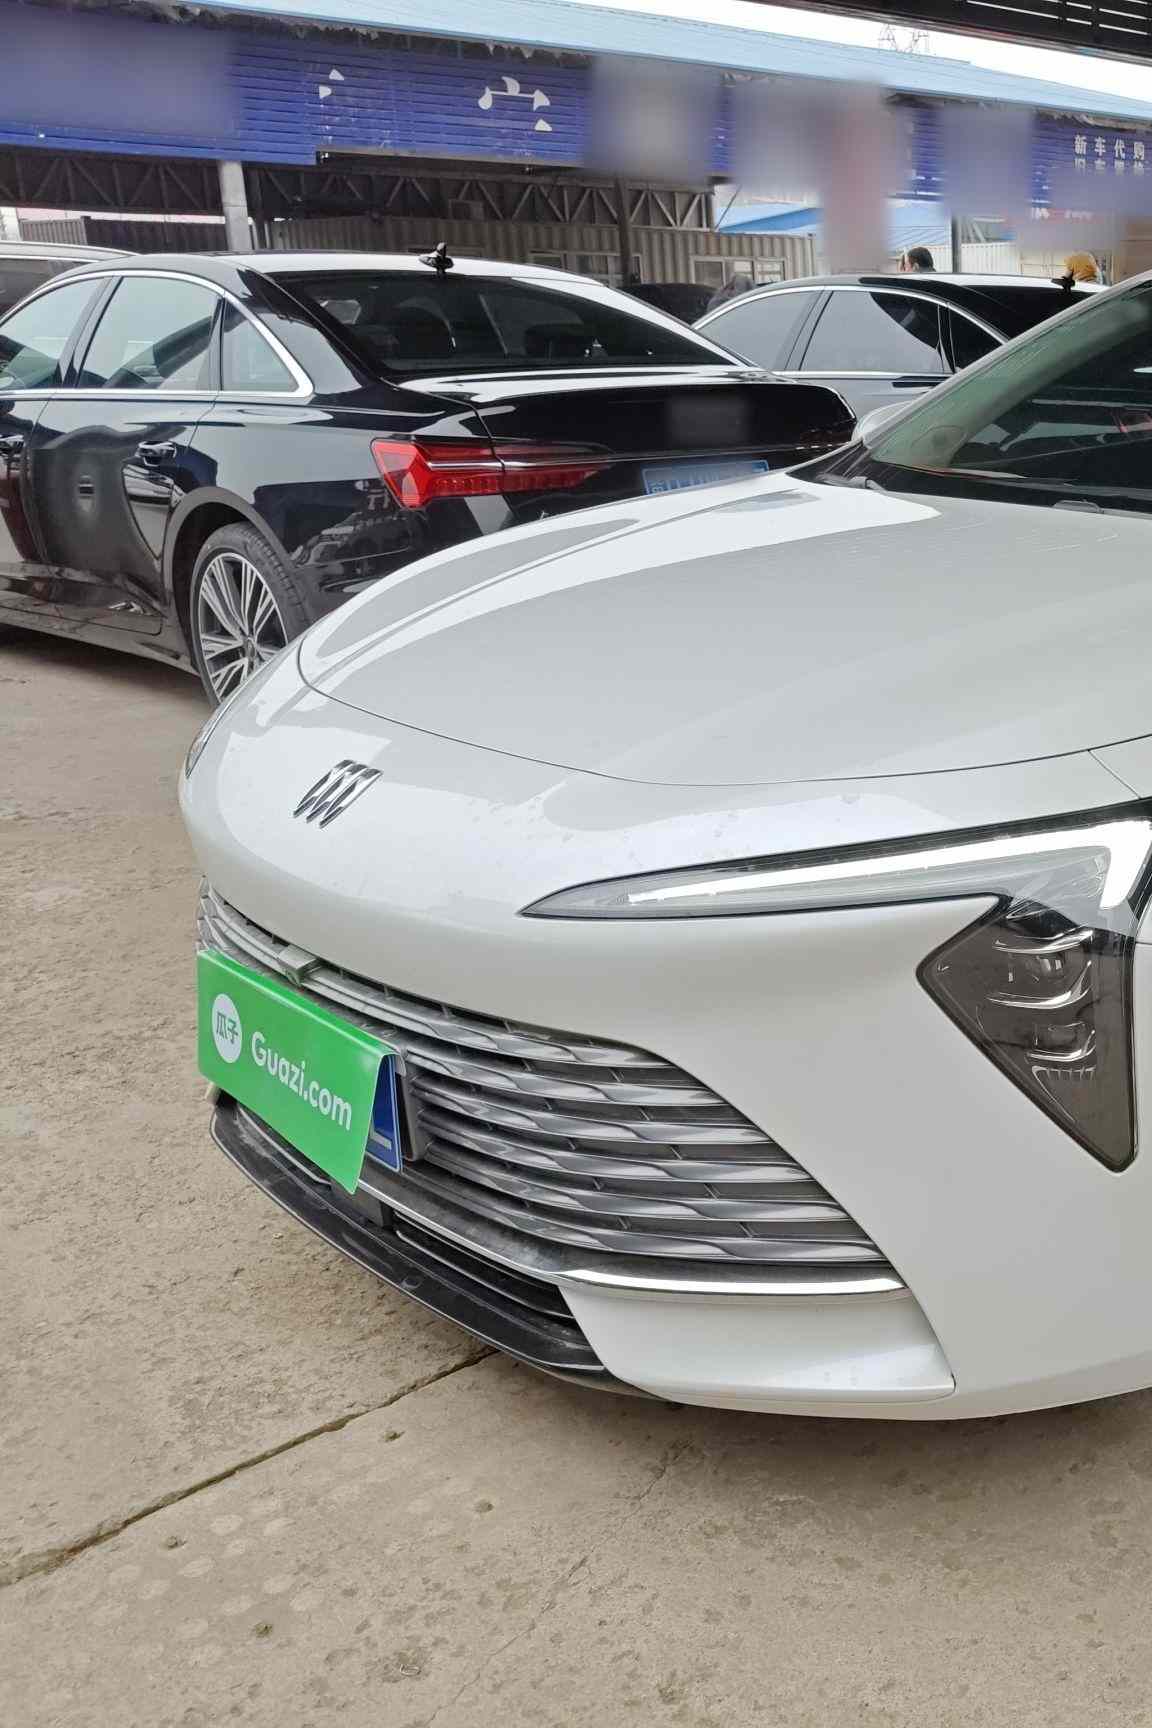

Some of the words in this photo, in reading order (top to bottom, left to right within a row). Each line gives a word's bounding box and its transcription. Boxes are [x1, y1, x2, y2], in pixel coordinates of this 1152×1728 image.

[1074, 133, 1145, 161] 新车代购
[215, 1011, 240, 1045] 瓜子
[251, 1031, 353, 1131] Guazi.com
